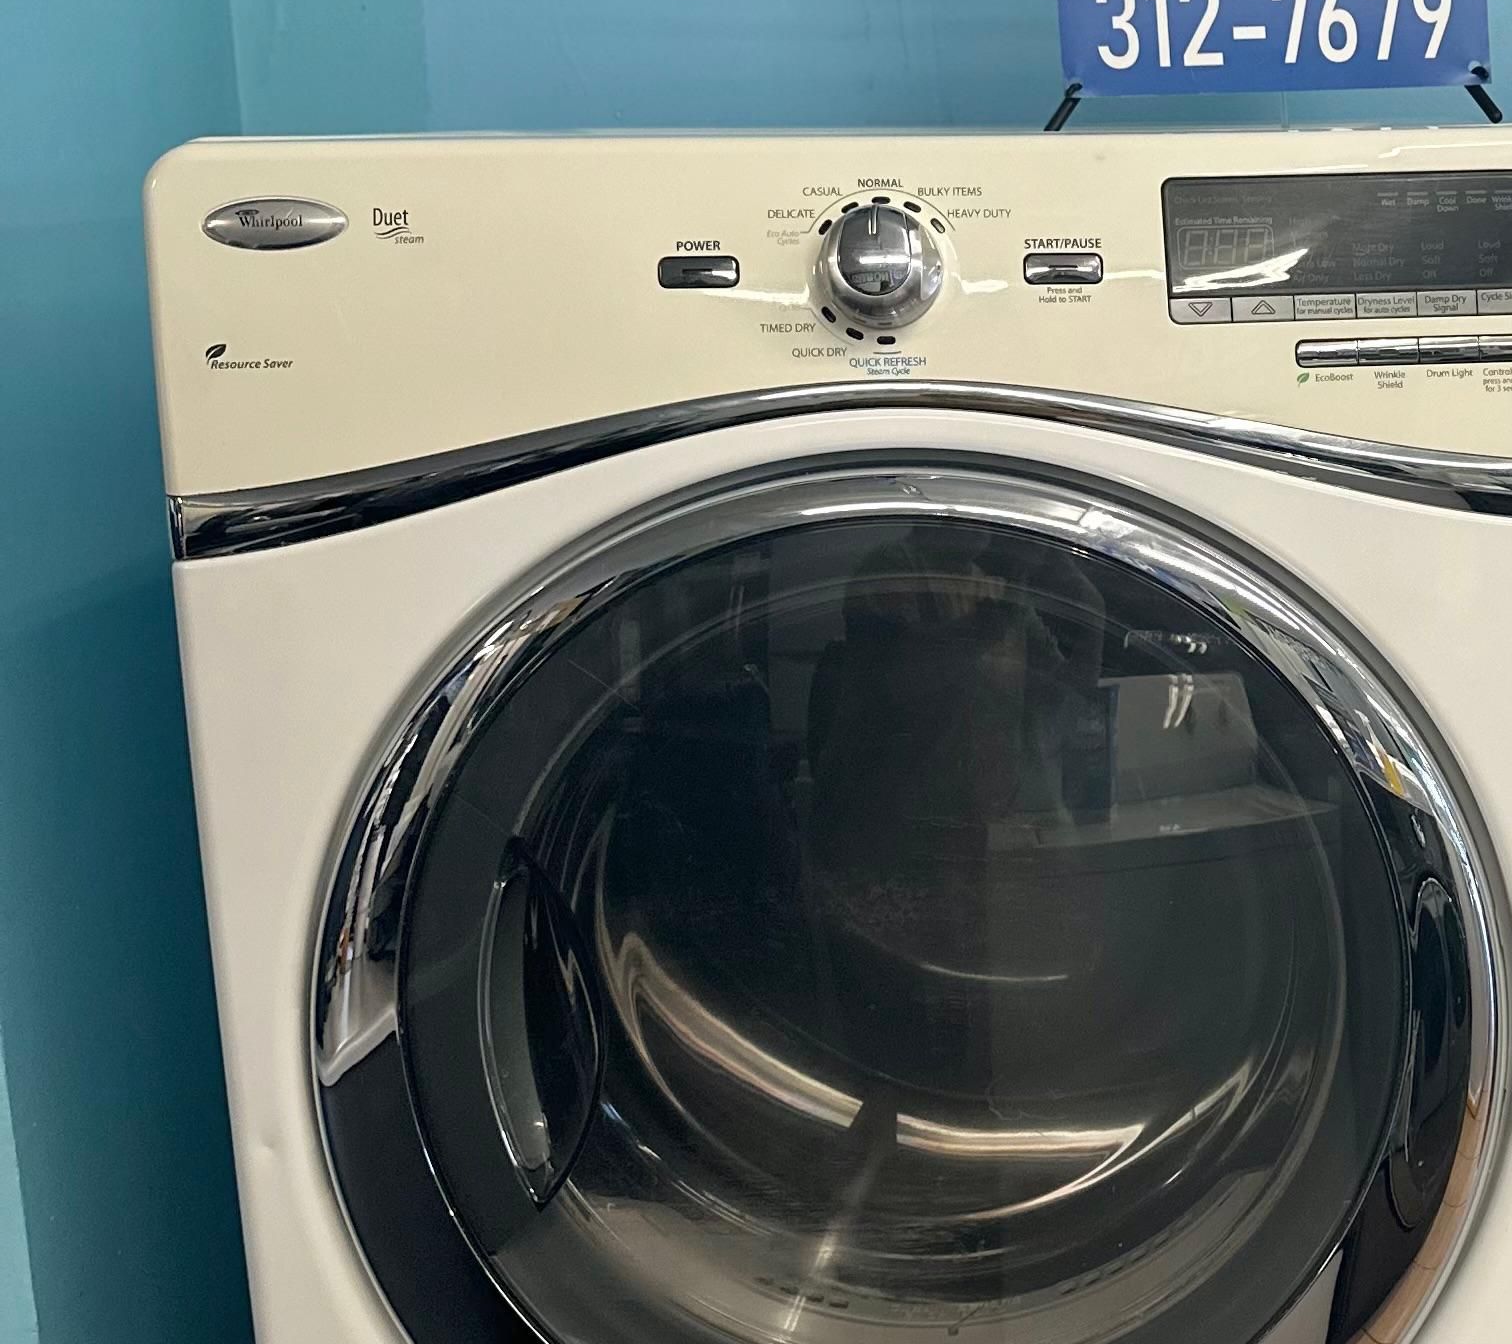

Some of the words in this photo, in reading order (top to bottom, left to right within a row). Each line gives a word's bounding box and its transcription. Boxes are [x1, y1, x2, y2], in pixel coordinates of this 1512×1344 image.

[857, 178, 904, 188] NORMAL
[802, 187, 843, 197] CASUAL
[917, 187, 950, 197] BULKY
[952, 186, 983, 196] ITEMS
[373, 208, 409, 227] Duet
[767, 209, 815, 219] DELICATE
[947, 208, 981, 219] HEAVY
[983, 208, 1012, 218] DUTY
[238, 213, 303, 230] Whirlpool
[394, 234, 424, 245] steam
[1024, 238, 1102, 249] START/PAUSE
[676, 240, 721, 252] POWER
[1047, 286, 1067, 294] Press
[1068, 286, 1082, 294] and
[1038, 295, 1057, 303] Hold
[1058, 295, 1067, 303] to
[1068, 295, 1092, 303] START
[1358, 296, 1391, 307] Dryness
[1393, 295, 1415, 306] Level
[1425, 295, 1448, 306] Damp
[1450, 294, 1466, 305] Dry
[1481, 292, 1503, 302] Cycle
[1297, 298, 1351, 308] Temperature
[1433, 303, 1458, 313] Signal
[760, 323, 792, 333] TIMED
[795, 323, 816, 333] DRY
[792, 348, 825, 358] QUICK
[827, 347, 847, 357] DRY
[211, 359, 261, 370] Resource
[264, 358, 293, 369] Saver
[850, 358, 882, 368] QUICK
[884, 357, 927, 367] REFRESH
[891, 367, 911, 376] Cycle
[1374, 370, 1406, 379] Wrinkle
[1426, 369, 1450, 378] Drum
[1451, 368, 1474, 379] Light
[1482, 367, 1512, 376] Control
[1315, 373, 1353, 382] EcoBoost
[1377, 380, 1403, 389] Shield
[1485, 384, 1496, 392] for
